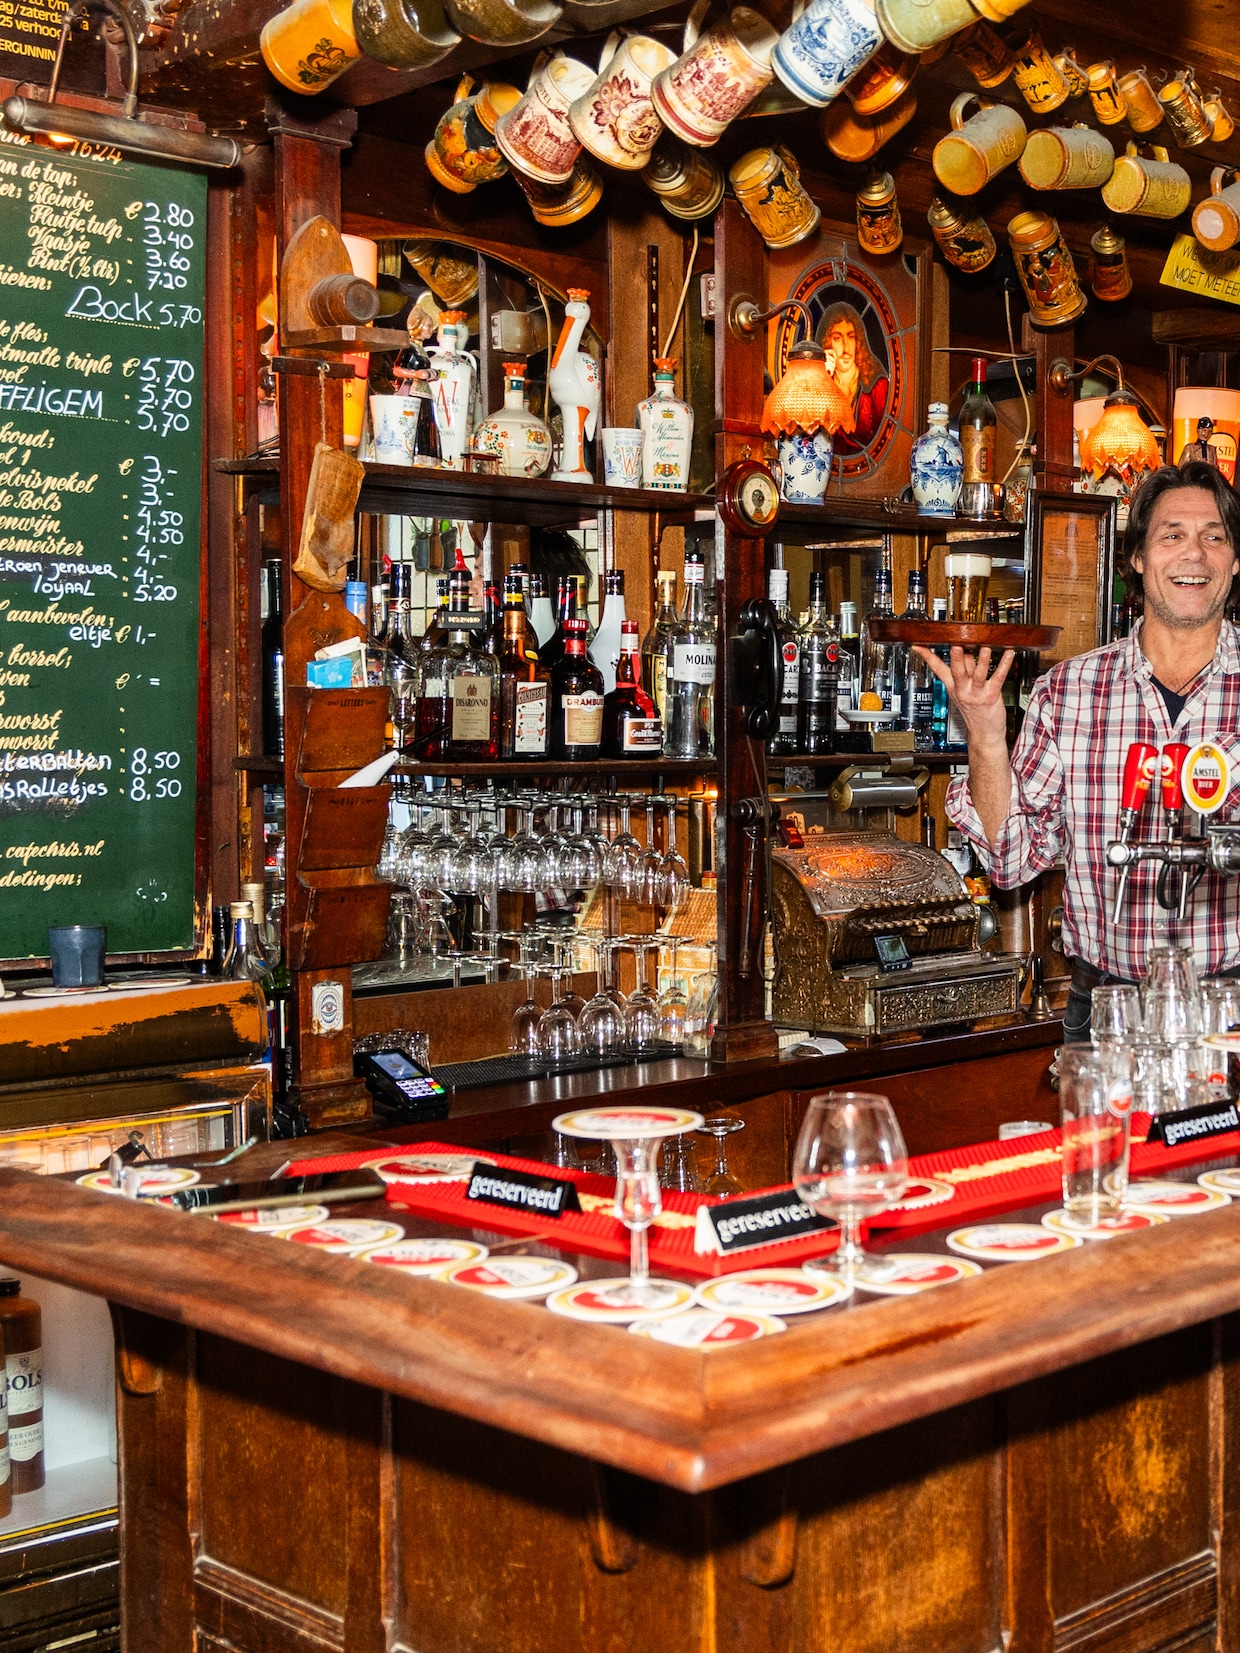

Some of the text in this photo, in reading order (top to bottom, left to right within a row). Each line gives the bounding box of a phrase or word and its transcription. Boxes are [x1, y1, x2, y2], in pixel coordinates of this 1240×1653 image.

[0, 1, 63, 24] ag/zaterda
[48, 0, 70, 12] t/m
[71, 140, 122, 165] 1624
[21, 161, 41, 180] de
[43, 163, 77, 189] tap;
[0, 178, 194, 227] er; Kleintje € 2.80
[87, 215, 122, 244] tulp
[143, 226, 194, 249] 3.40
[28, 225, 191, 271] Vaasje 3.60
[28, 246, 70, 271] Pint
[0, 264, 52, 290] ieren;
[1173, 265, 1205, 286] MOET
[10, 321, 48, 344] fles;
[0, 343, 61, 367] tmalle
[66, 351, 113, 377] triple
[122, 358, 140, 377] €
[21, 449, 31, 466] 1
[119, 458, 134, 475] €
[1216, 446, 1235, 457] STEL
[13, 490, 62, 512] Bols
[6, 602, 115, 629] aanbevolen;
[7, 643, 73, 669] borrel;
[456, 697, 488, 707] DISARONNO
[0, 709, 63, 730] worst
[1193, 768, 1220, 778] AMSTEL
[1198, 781, 1214, 789] BIER
[1164, 1108, 1240, 1146] gereserveerd
[469, 1174, 564, 1212] gereserveerd
[716, 1203, 817, 1243] gereserveer
